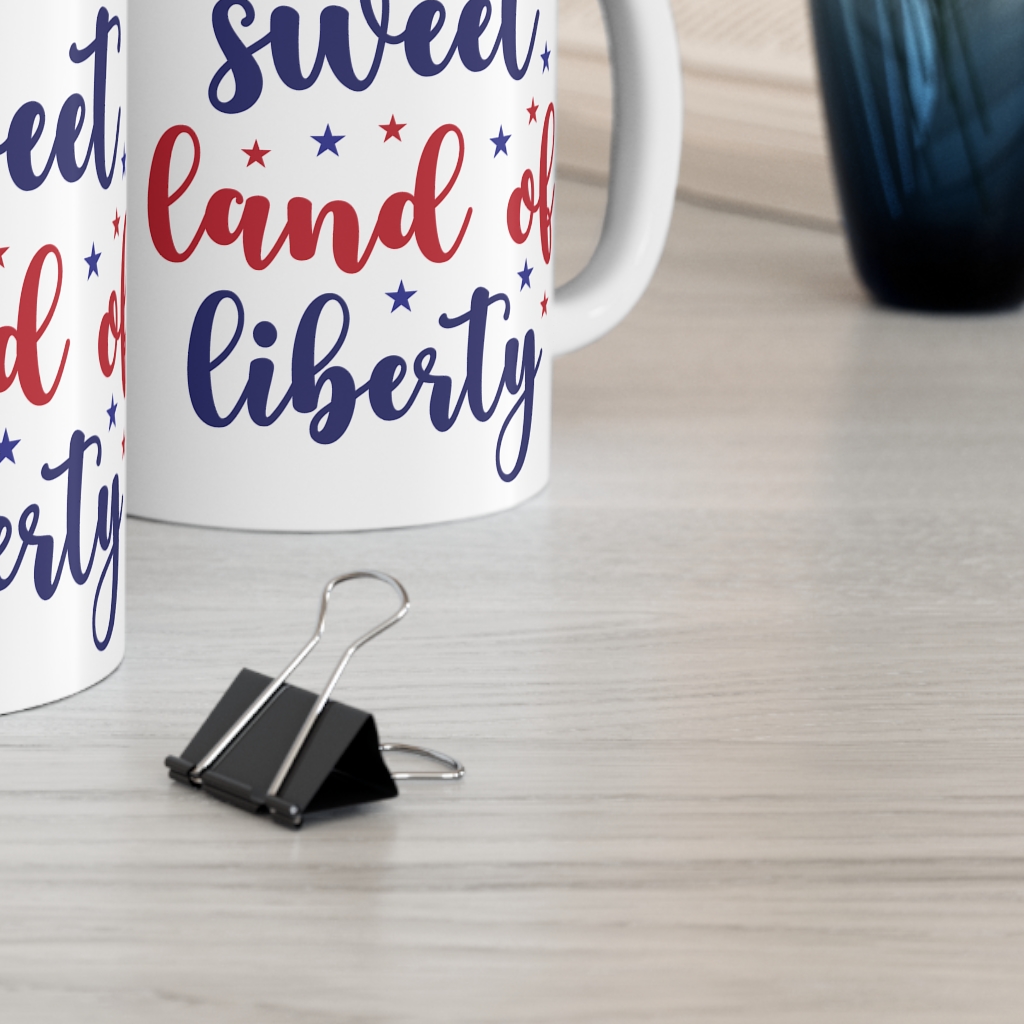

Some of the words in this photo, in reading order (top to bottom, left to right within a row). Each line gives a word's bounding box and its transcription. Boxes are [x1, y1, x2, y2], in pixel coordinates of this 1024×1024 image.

[147, 123, 473, 275] land
[506, 102, 555, 265] of
[187, 287, 542, 483] liberty
